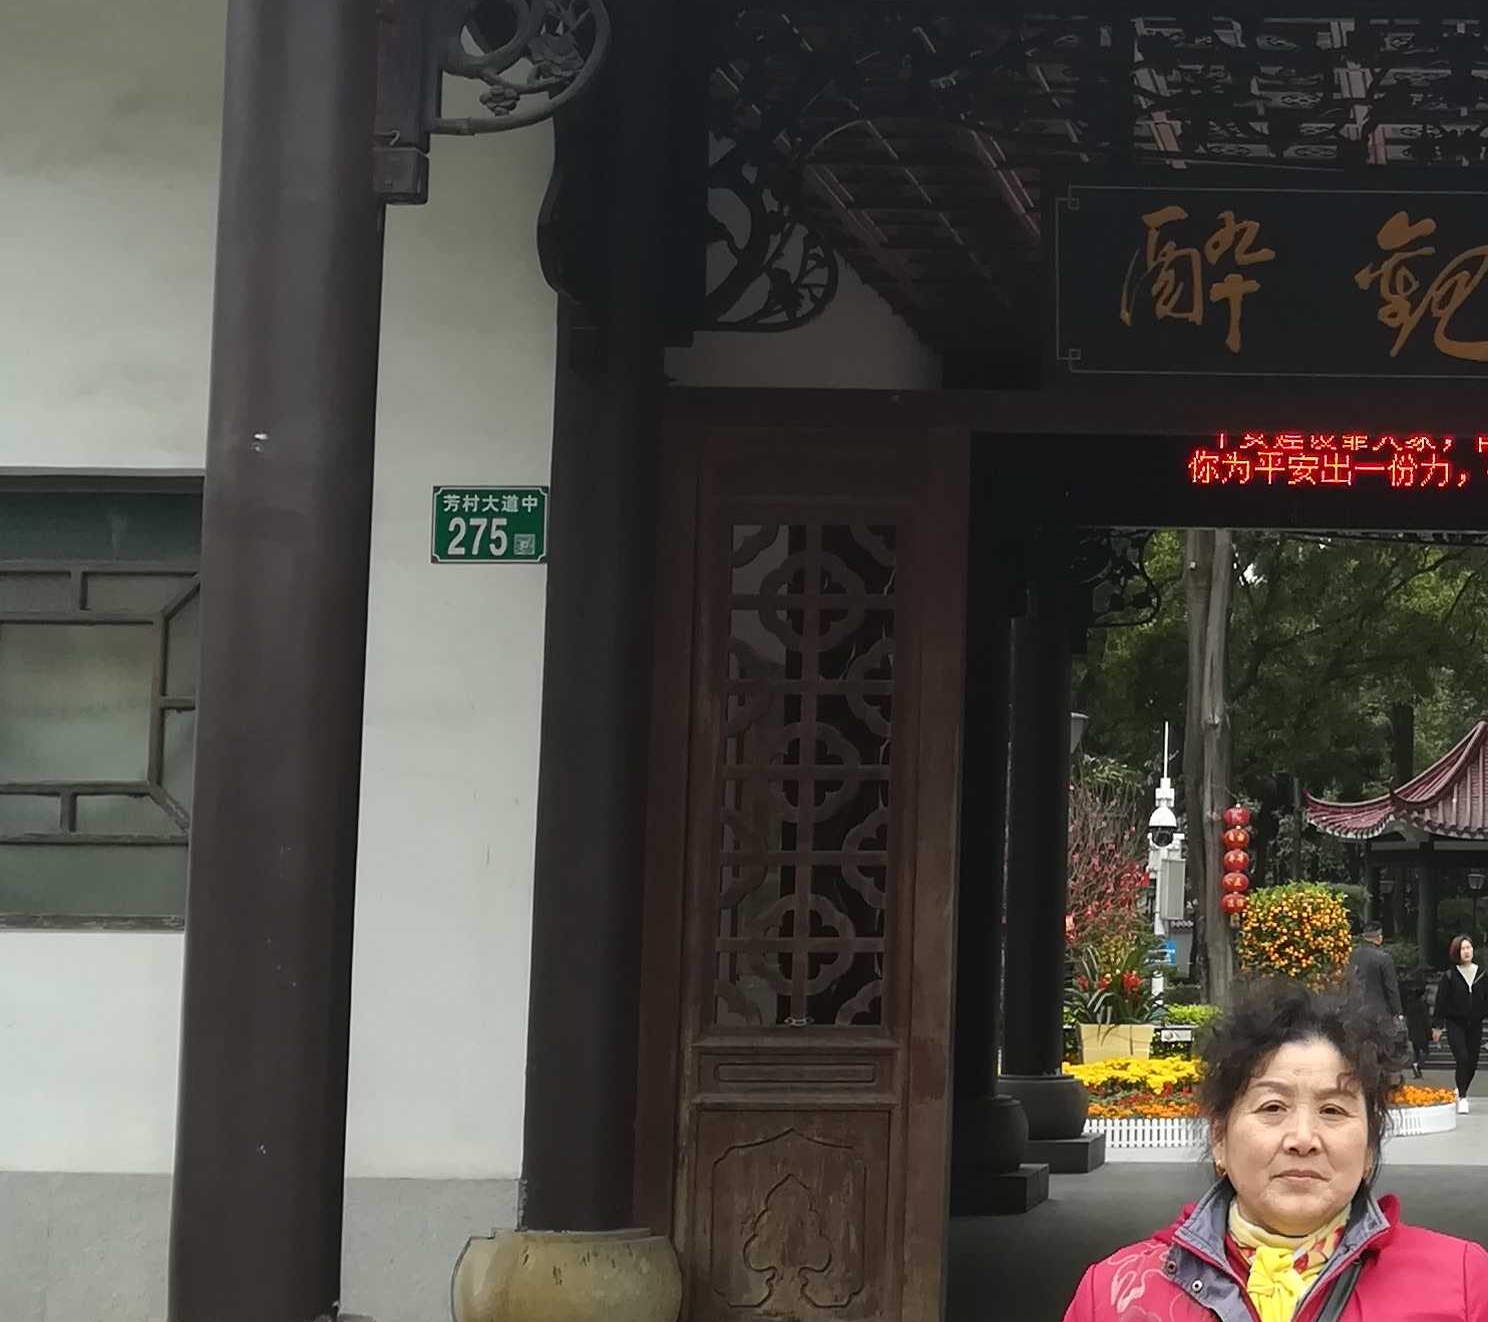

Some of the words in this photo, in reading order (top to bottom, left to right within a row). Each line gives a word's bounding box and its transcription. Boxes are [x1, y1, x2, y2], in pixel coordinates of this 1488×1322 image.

[443, 494, 538, 513] 芳村大道中
[447, 517, 508, 556] 275
